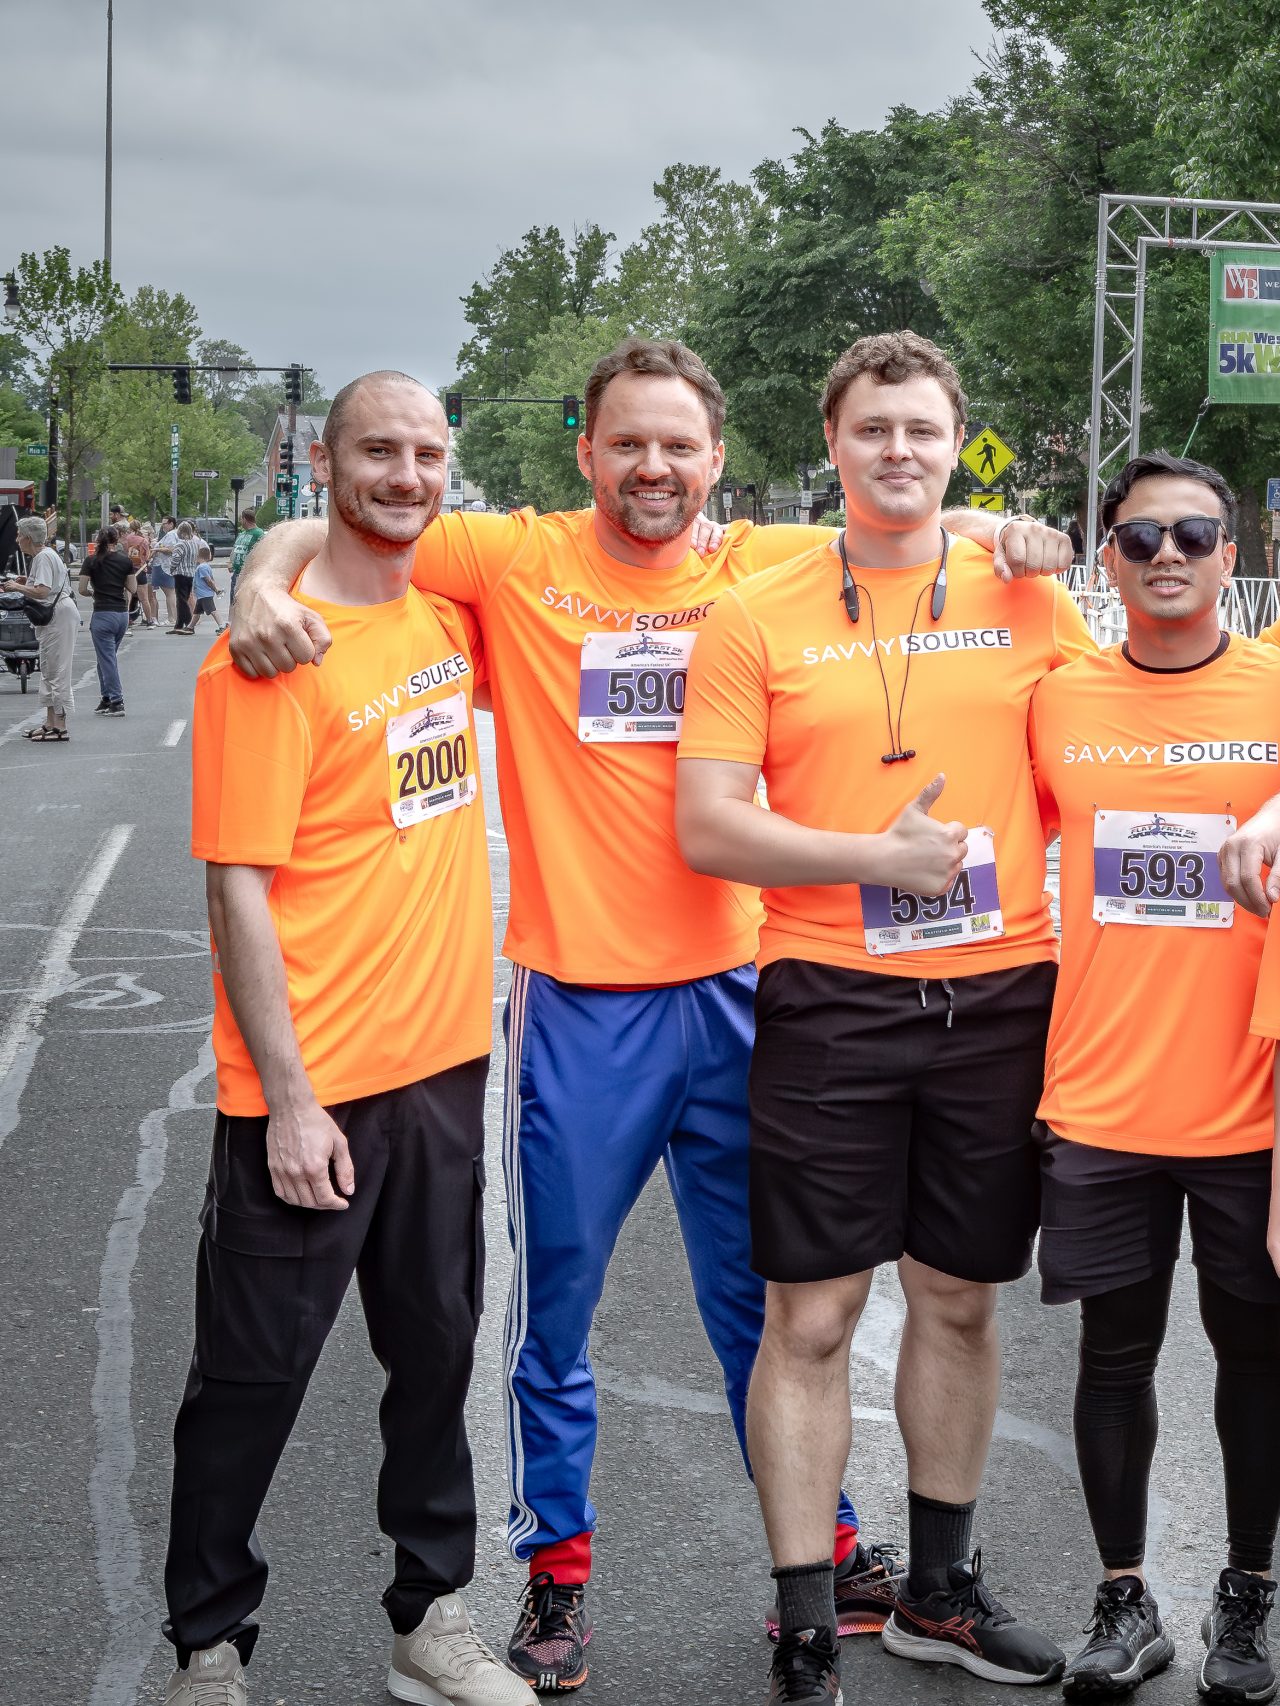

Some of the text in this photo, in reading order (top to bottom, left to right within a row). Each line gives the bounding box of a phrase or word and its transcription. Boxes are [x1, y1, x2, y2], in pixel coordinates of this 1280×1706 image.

[1227, 268, 1257, 299] WB
[1220, 331, 1253, 343] RUN
[1220, 343, 1255, 373] 5k
[540, 586, 715, 631] SAVVY SOURC
[803, 630, 1011, 665] SAVVY SOURCE
[410, 654, 468, 694] SOURCE
[608, 670, 688, 715] 590
[397, 735, 466, 798] 2000
[1063, 742, 1278, 764] SAVVY SOURCE
[1120, 852, 1205, 899] 593
[890, 869, 976, 925] 594
